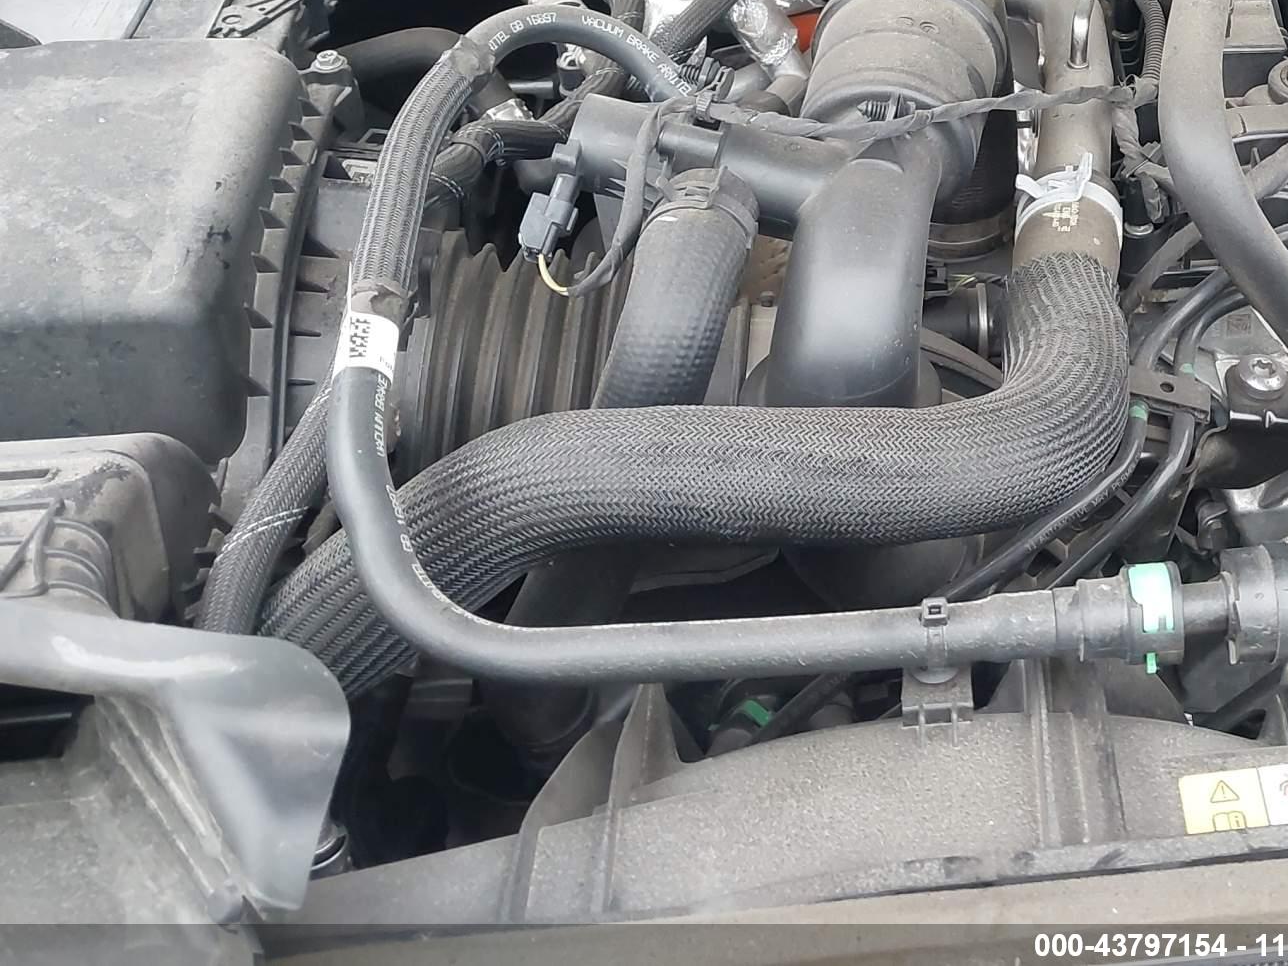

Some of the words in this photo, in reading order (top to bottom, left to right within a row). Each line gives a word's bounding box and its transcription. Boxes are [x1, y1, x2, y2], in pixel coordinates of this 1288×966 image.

[509, 19, 524, 33] GB
[581, 14, 625, 40] VACUUM
[625, 33, 659, 64] BRAKE
